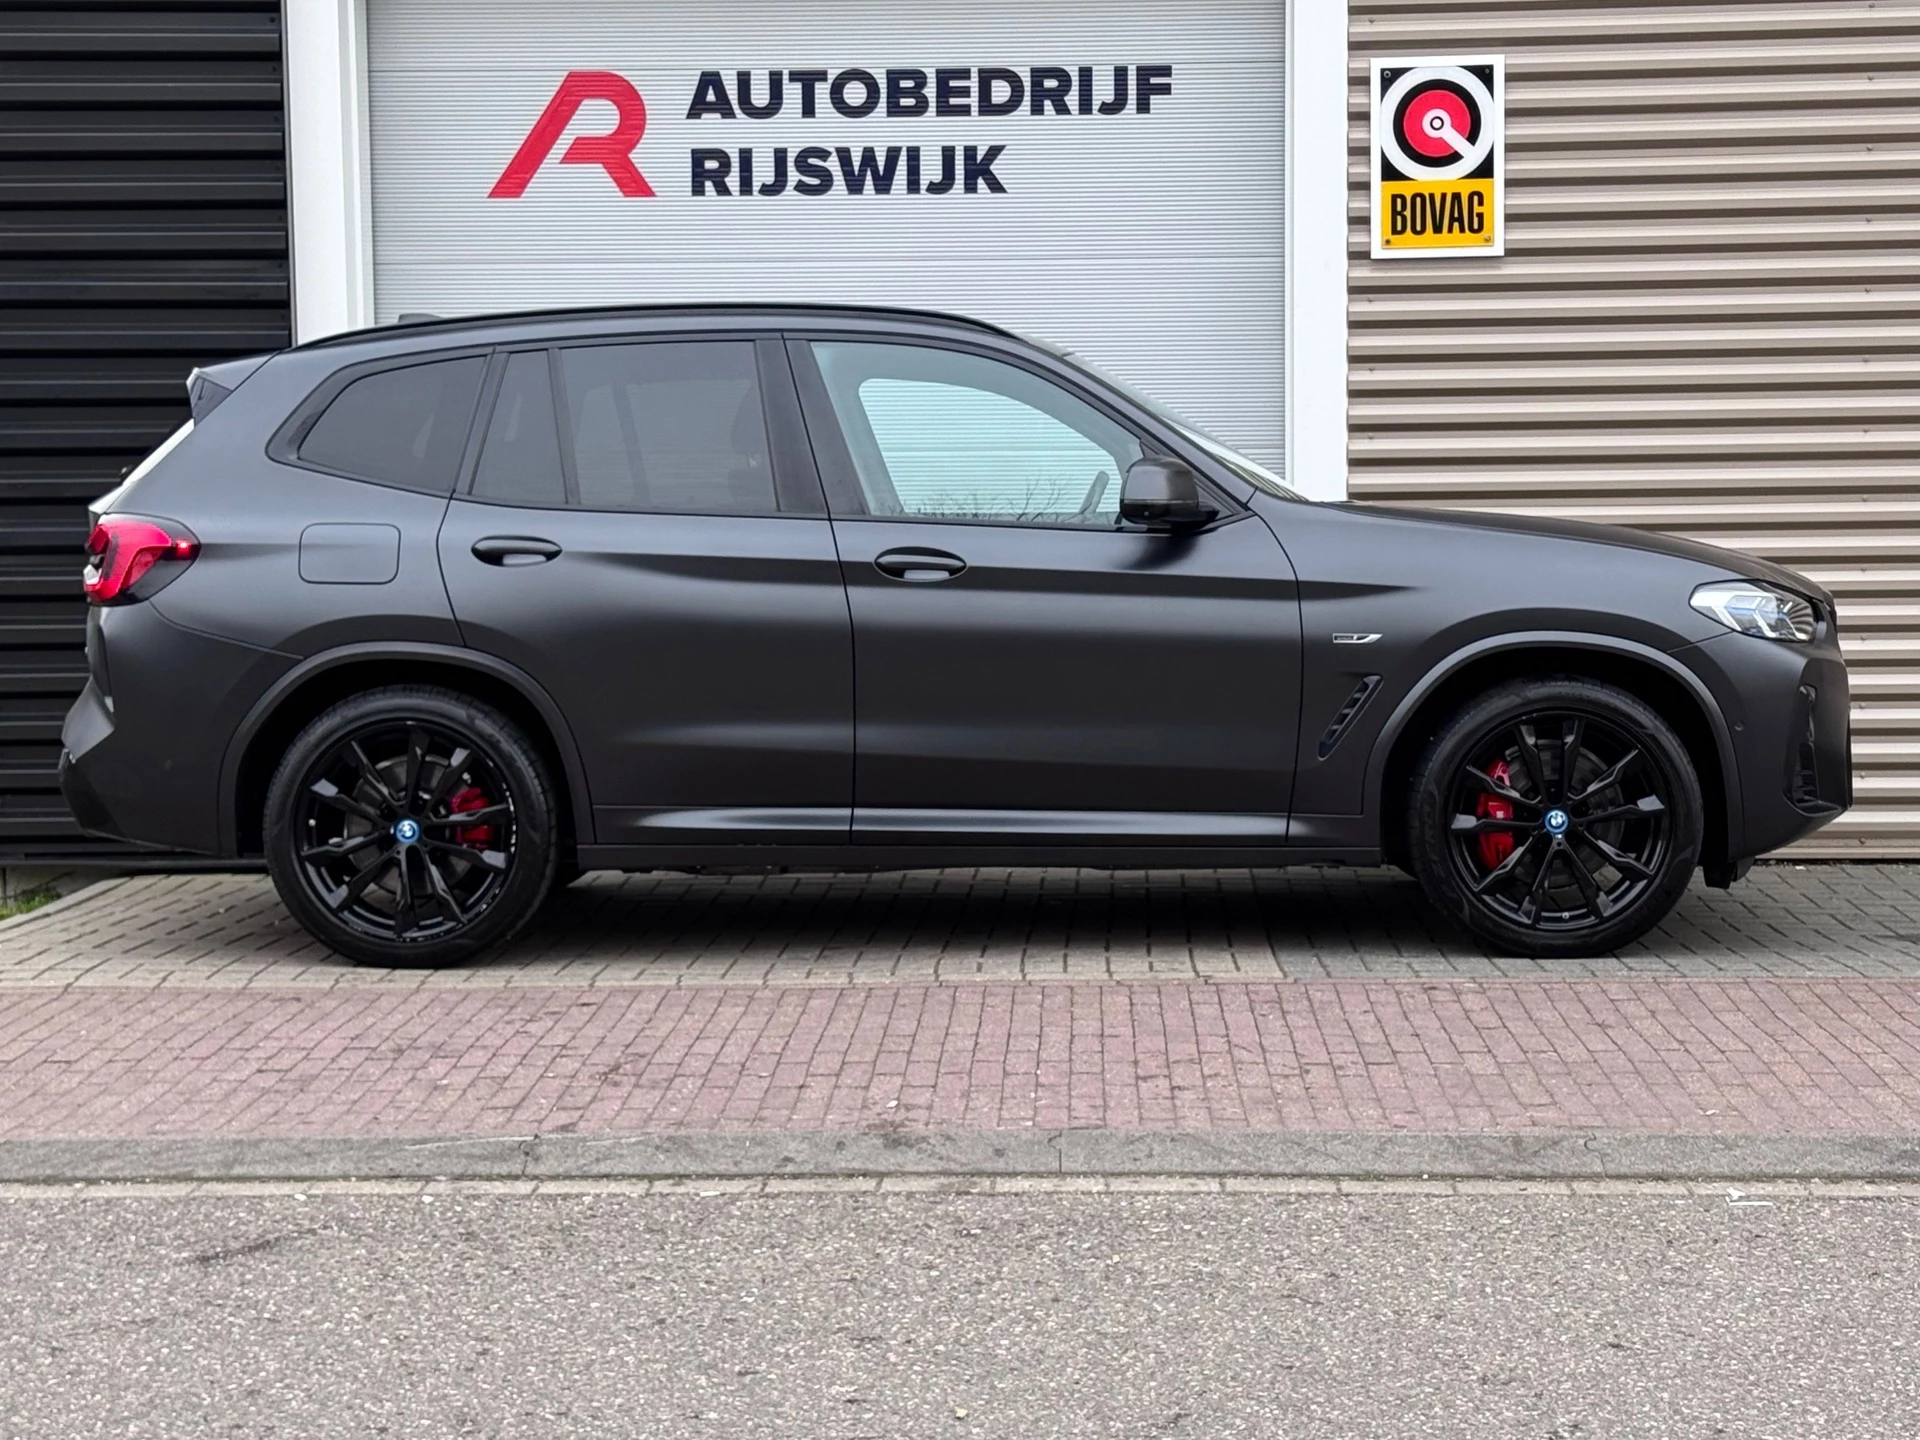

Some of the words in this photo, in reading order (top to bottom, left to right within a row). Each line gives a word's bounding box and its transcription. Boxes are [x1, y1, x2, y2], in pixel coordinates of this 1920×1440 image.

[686, 65, 1173, 120] AUTOBEDRIJF
[690, 144, 1008, 197] RIJSWIJK
[1390, 190, 1485, 236] BOVAG
